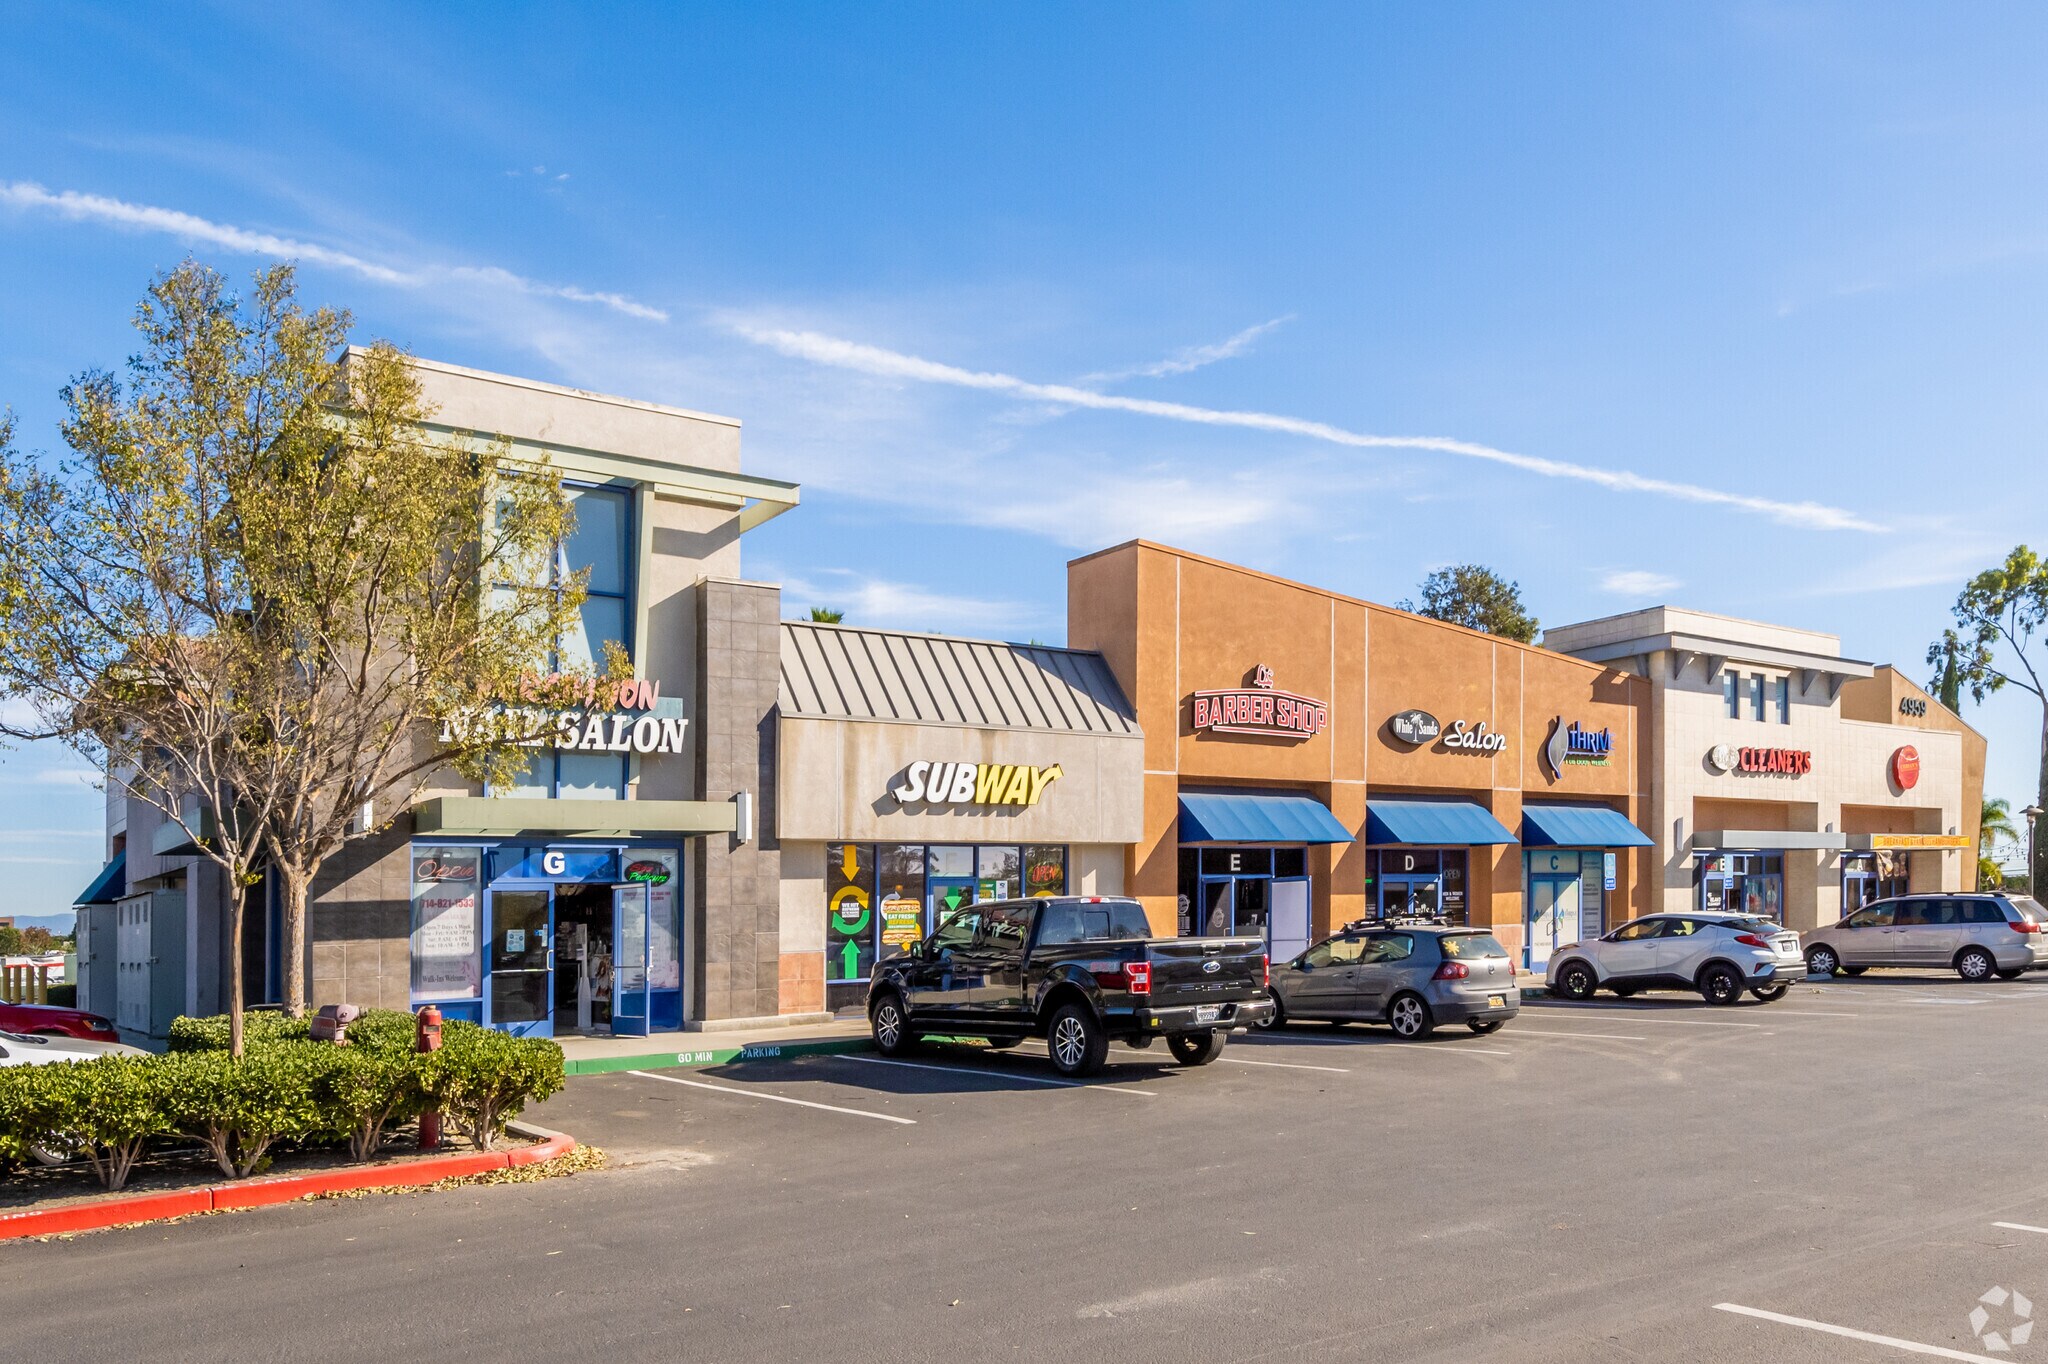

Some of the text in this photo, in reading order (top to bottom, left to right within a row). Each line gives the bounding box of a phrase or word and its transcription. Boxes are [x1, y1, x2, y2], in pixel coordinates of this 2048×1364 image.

[1194, 695, 1327, 734] BARBER SHOP
[1901, 698, 1927, 716] 4959
[555, 711, 689, 754] SALON
[1395, 718, 1438, 736] White Sands
[1443, 720, 1506, 751] Salon
[1569, 720, 1616, 753] THRIVE
[1740, 746, 1811, 774] CLEANERS
[892, 760, 1064, 804] SUBWAY
[417, 859, 474, 881] Open
[543, 851, 565, 874] G
[1230, 853, 1240, 871] E
[1405, 855, 1414, 871] D
[1550, 855, 1558, 870] C
[1857, 859, 1863, 871] A
[628, 871, 668, 882] Pedicure
[1032, 864, 1057, 882] OPEN
[420, 898, 474, 908] 714-821-1533
[694, 1051, 713, 1062] MIN
[741, 1046, 781, 1059] PARKING
